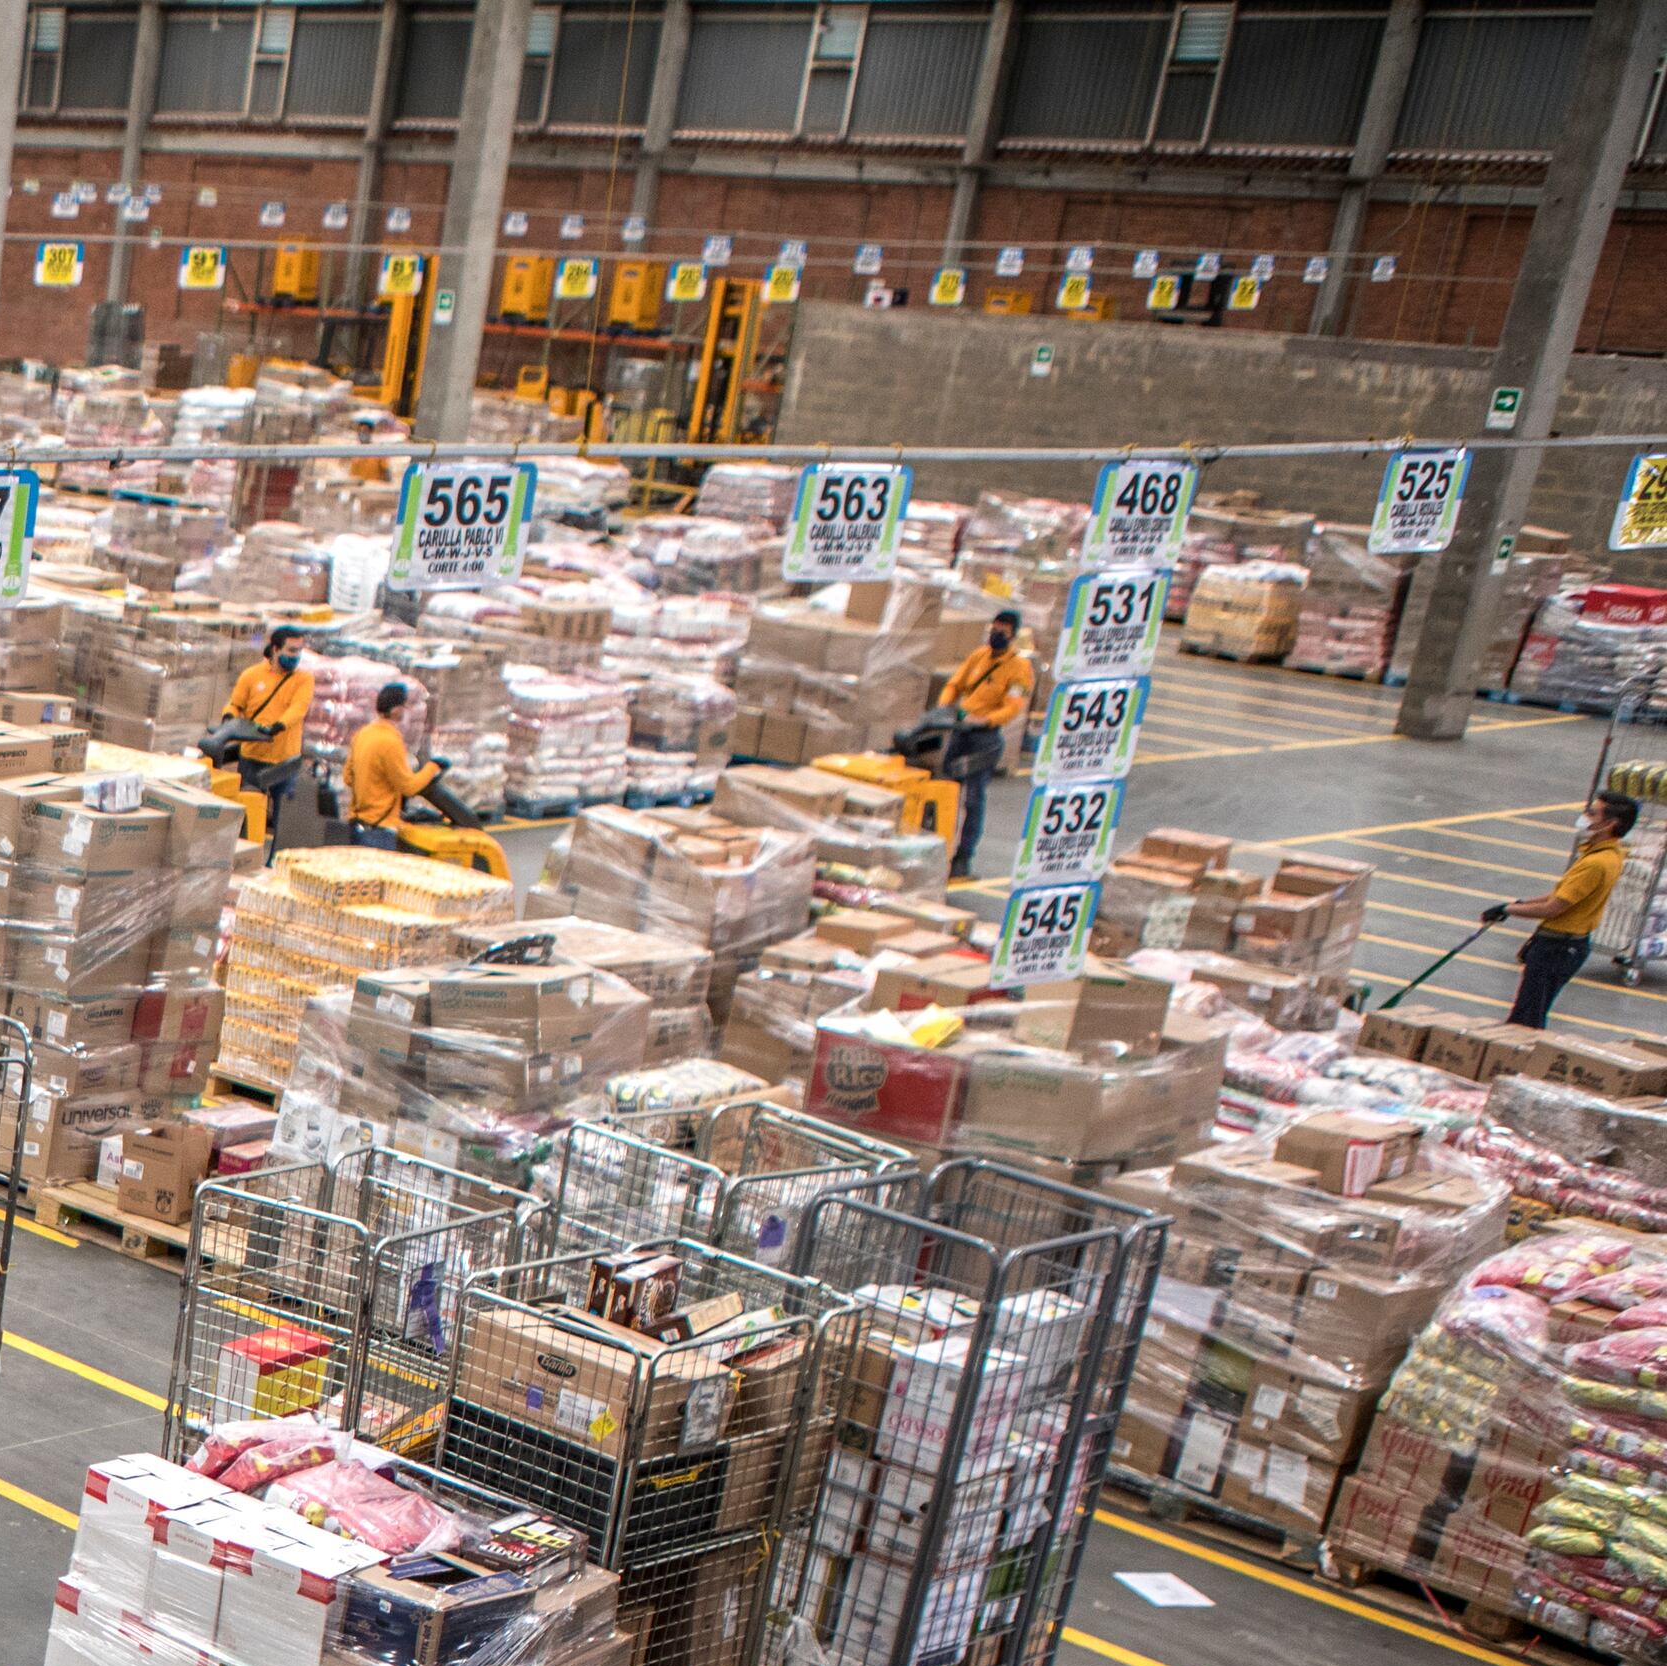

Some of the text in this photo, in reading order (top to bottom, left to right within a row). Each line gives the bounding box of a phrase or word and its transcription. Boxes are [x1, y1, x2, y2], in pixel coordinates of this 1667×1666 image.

[424, 476, 512, 526] 565
[817, 476, 891, 521] 563
[1115, 473, 1182, 515] 468
[1397, 460, 1455, 501] 525
[419, 527, 493, 547] CARULLA PABLO
[810, 524, 845, 541] CARULLA
[423, 548, 493, 560] L-M-W-J-V-S
[428, 562, 459, 574] CORTE
[1089, 582, 1156, 626] 531
[1063, 689, 1128, 731] 543
[1042, 792, 1107, 835] 532
[1018, 895, 1081, 937] 545
